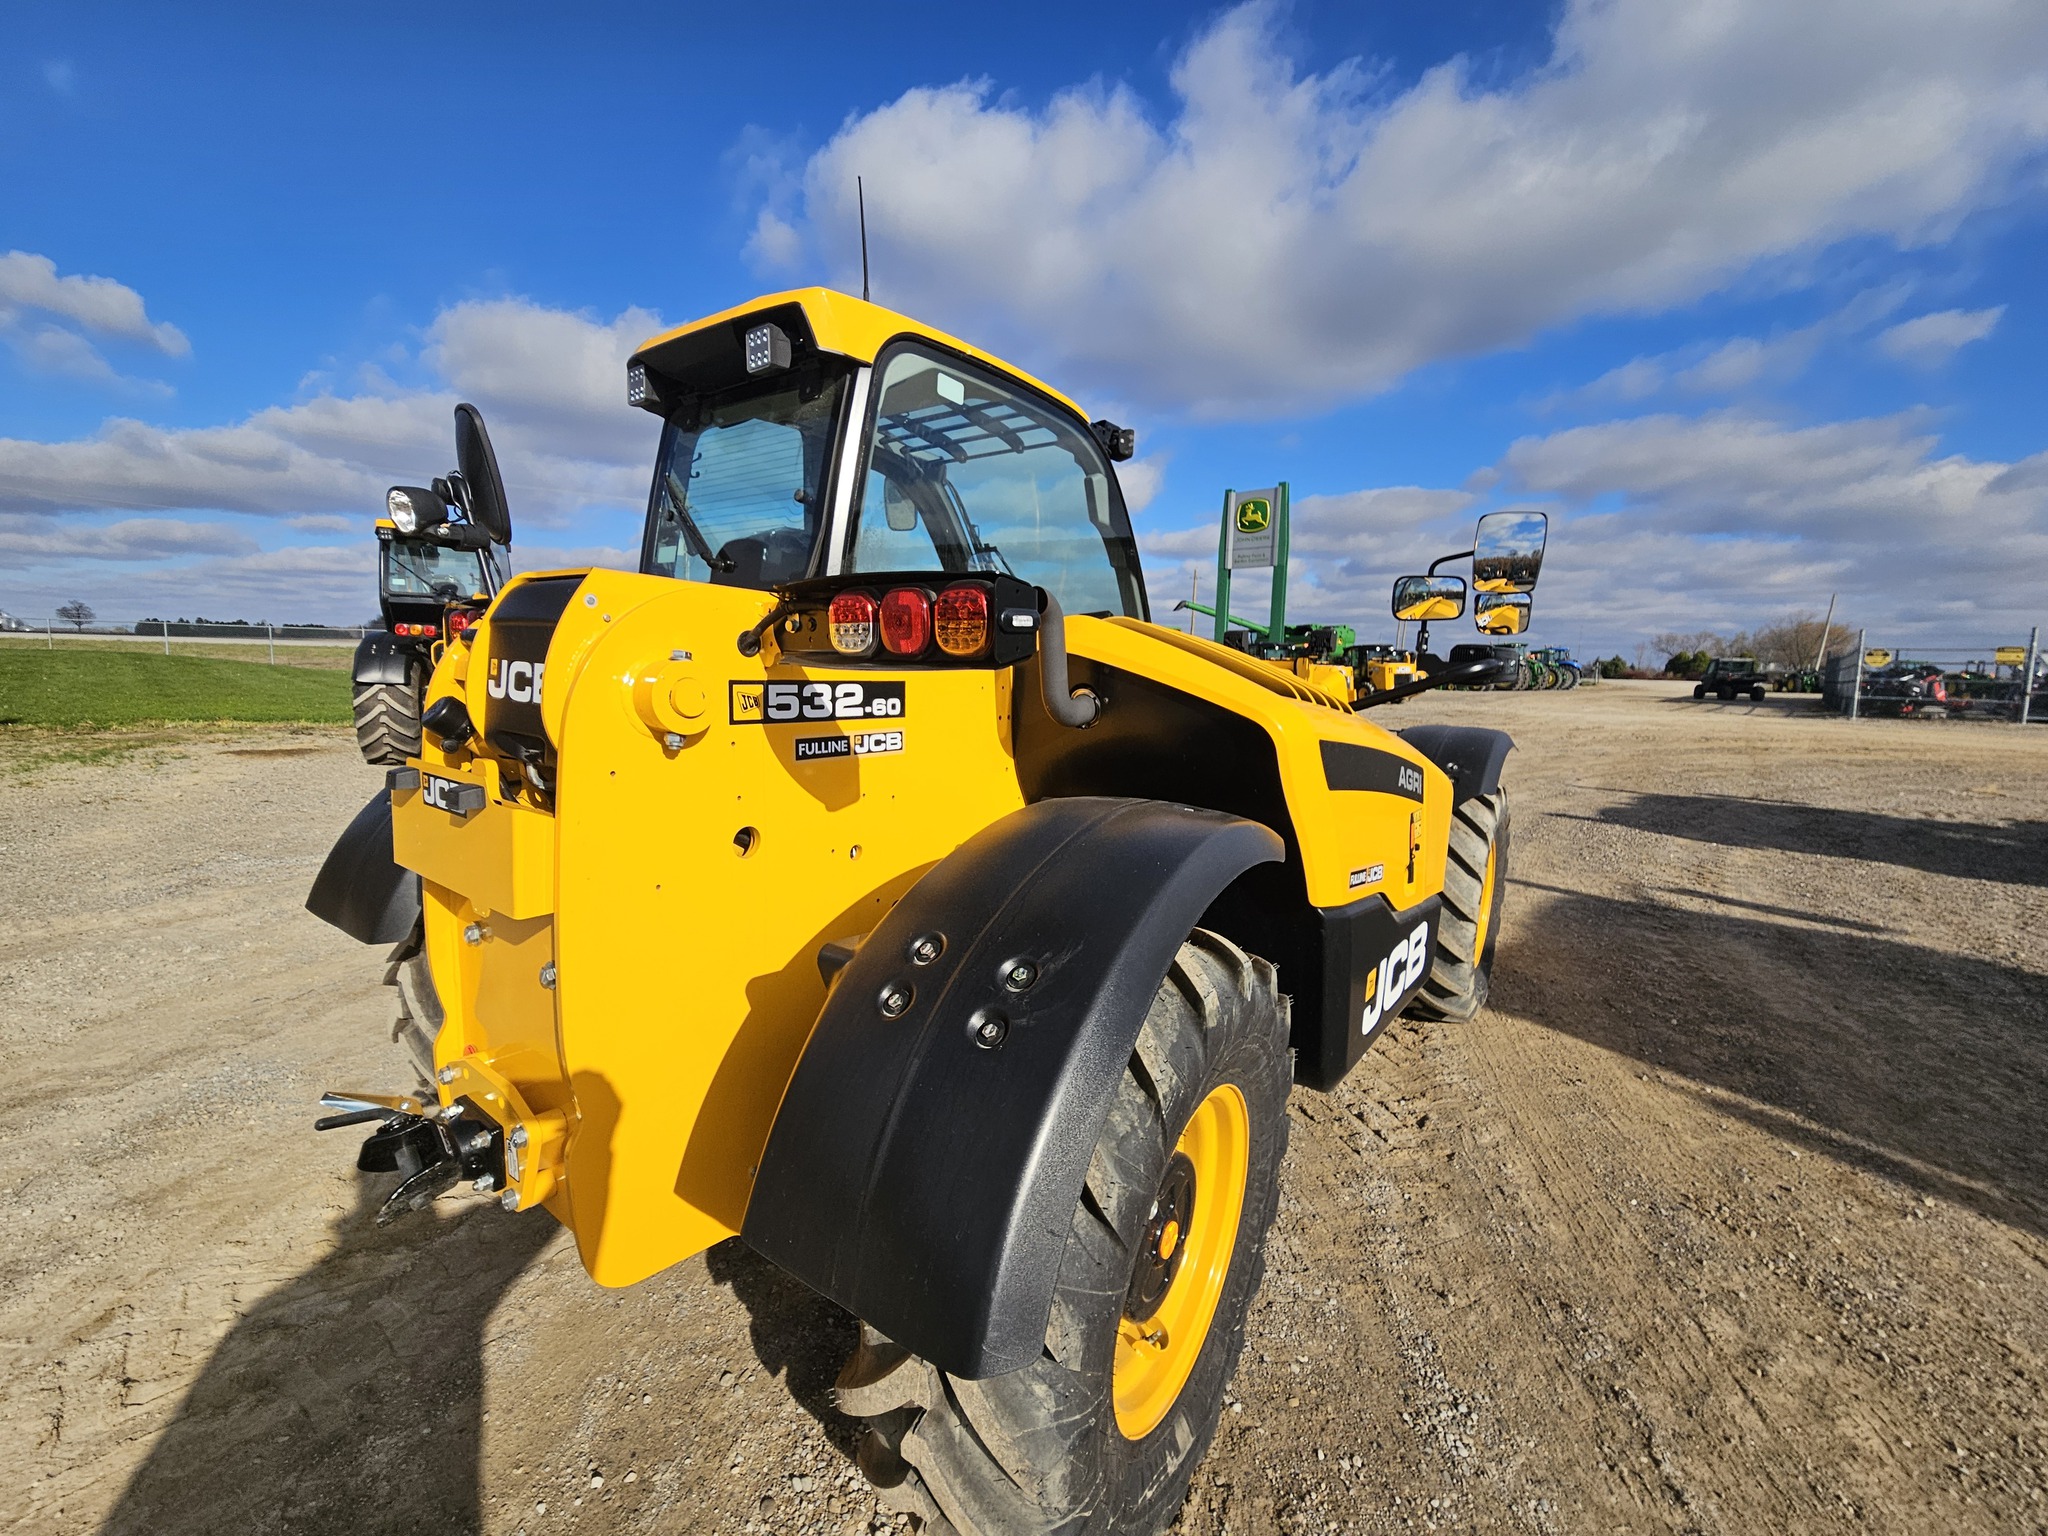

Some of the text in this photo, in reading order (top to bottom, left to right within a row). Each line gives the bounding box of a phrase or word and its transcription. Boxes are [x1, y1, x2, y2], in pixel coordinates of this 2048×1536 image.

[740, 694, 760, 711] JCB
[798, 732, 903, 756] FULLINE JCB
[1398, 765, 1422, 795] AGRI
[423, 776, 466, 814] JC
[1367, 866, 1383, 882] JCB
[1362, 920, 1429, 1036] JCB
